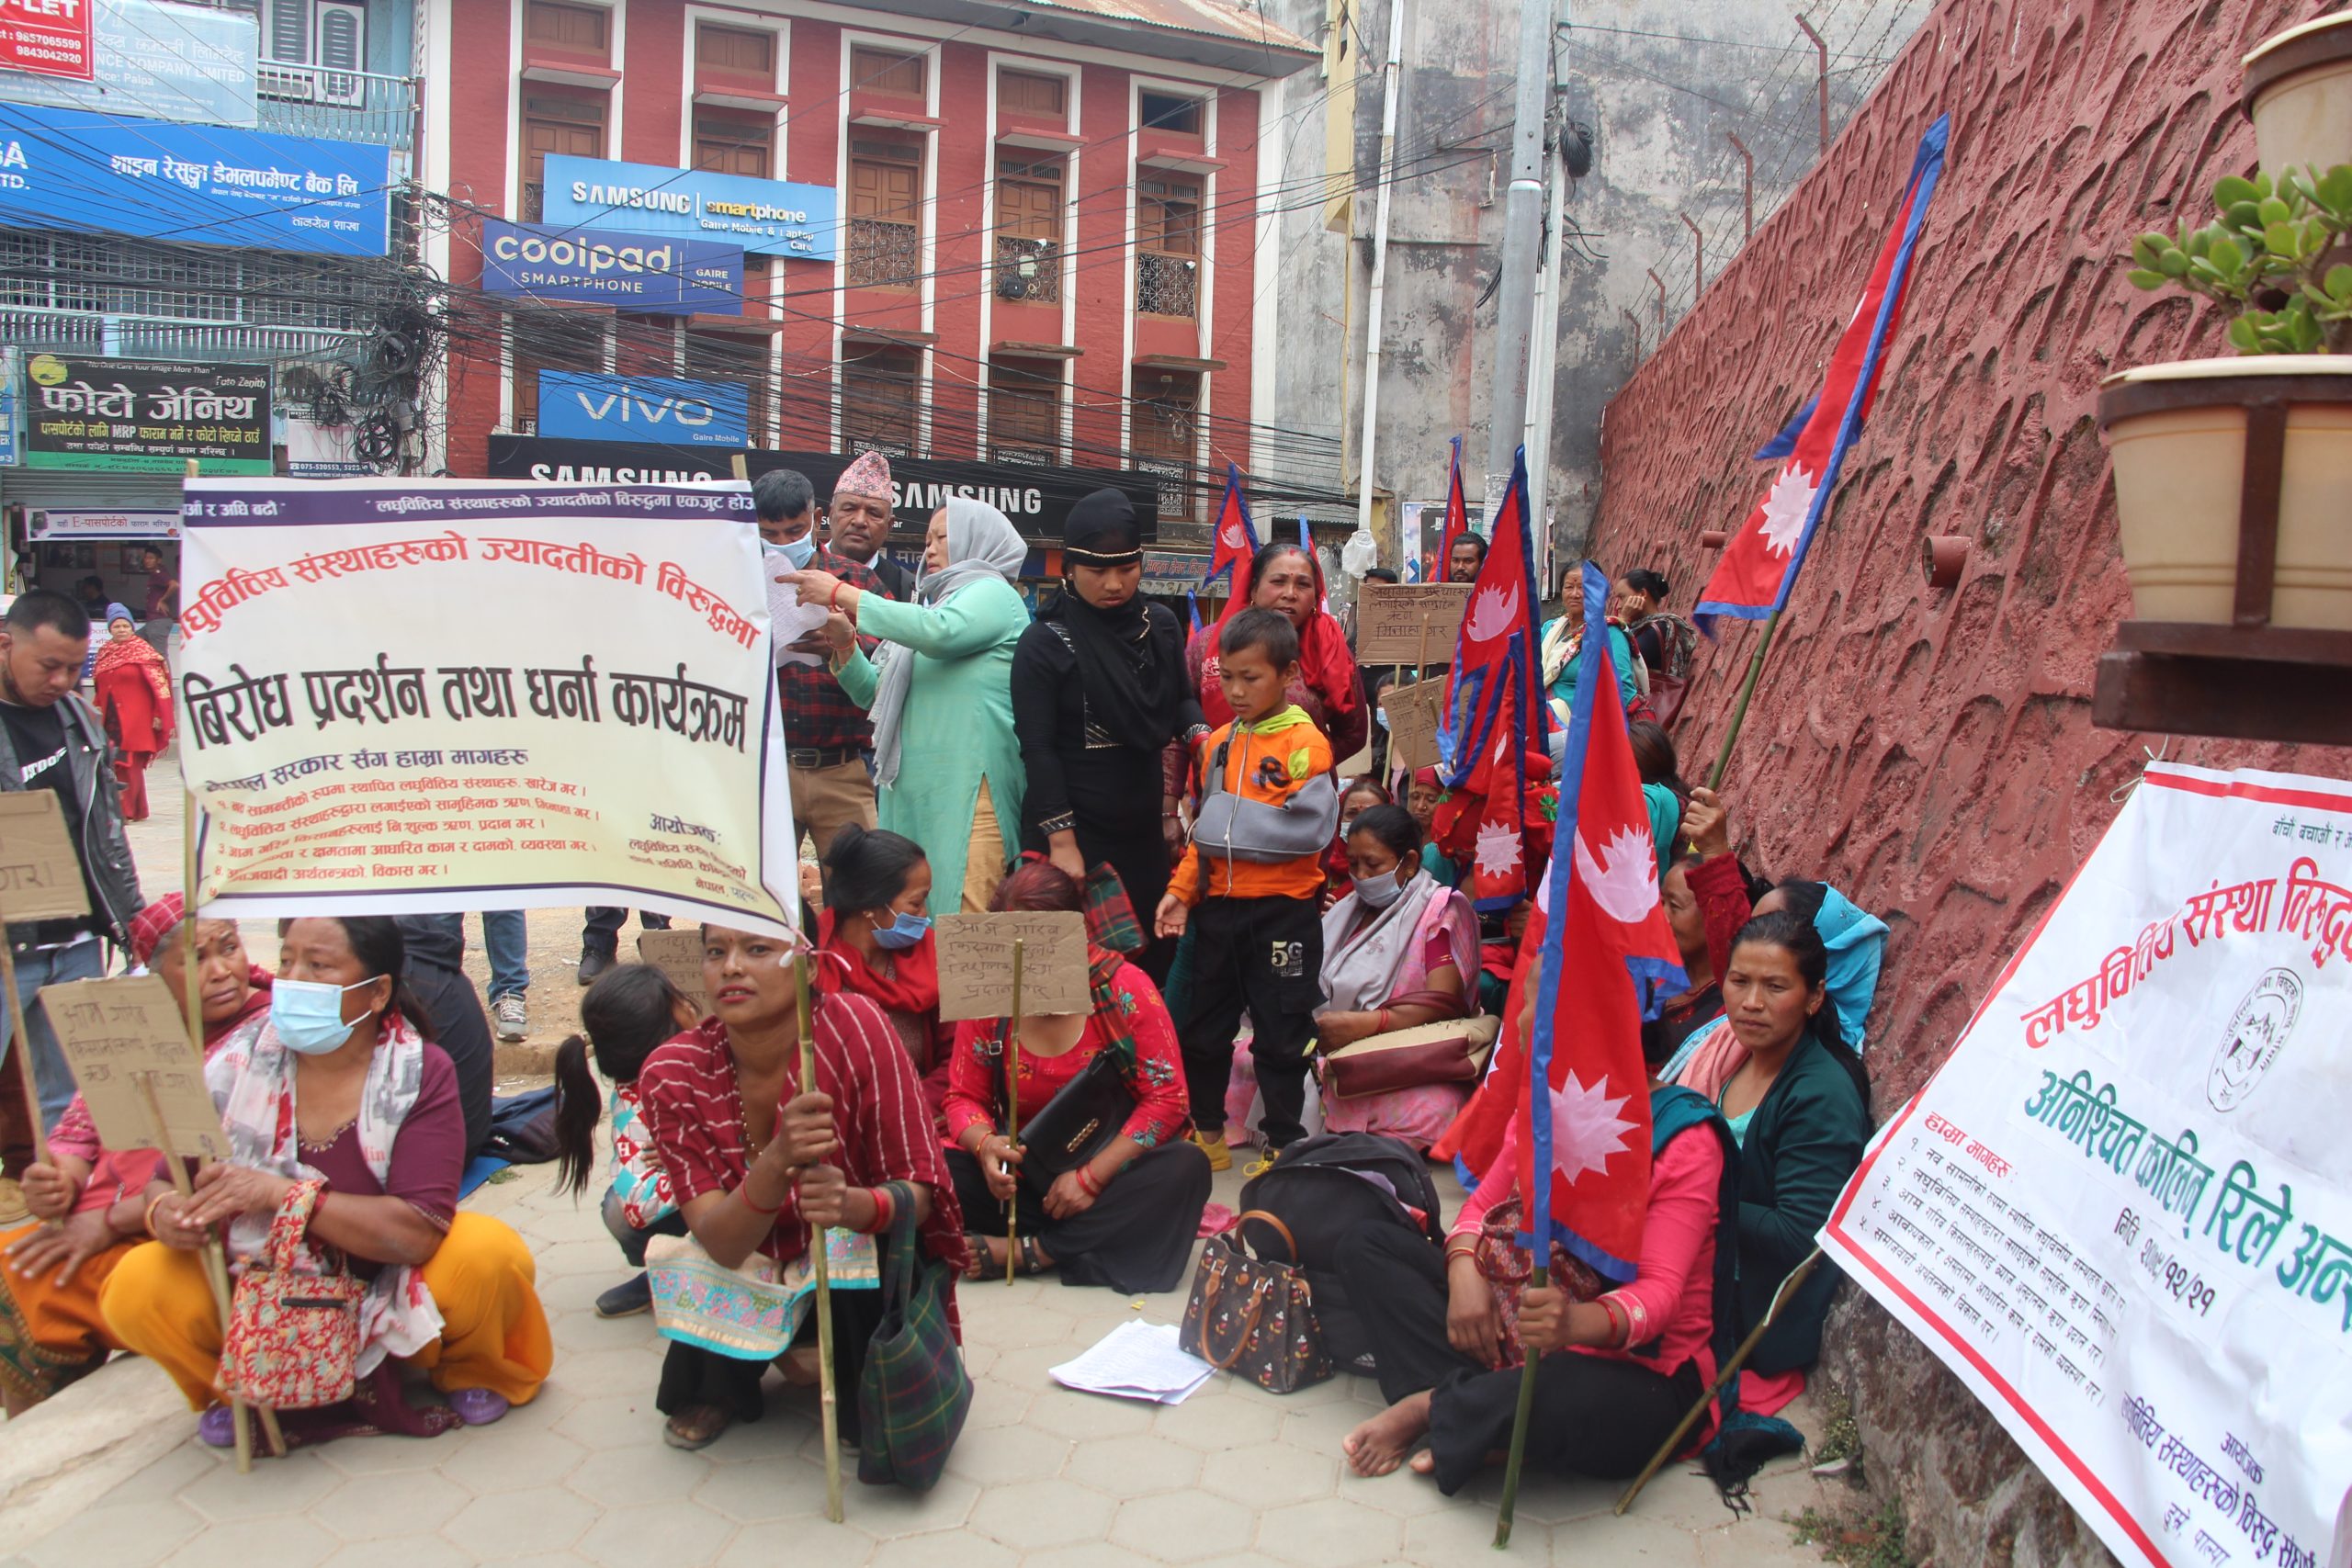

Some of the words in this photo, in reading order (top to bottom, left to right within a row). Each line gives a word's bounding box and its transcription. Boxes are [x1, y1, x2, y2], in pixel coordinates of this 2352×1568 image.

[16, 31, 81, 50] 9857065599
[17, 45, 82, 63] 9843042920
[124, 73, 154, 86] Palpa
[127, 57, 192, 76] COMPANY
[196, 69, 245, 83] LIMITED
[572, 180, 692, 215] SAMSUNG
[706, 200, 807, 223] smartphone
[767, 226, 775, 237] &
[494, 234, 672, 276] coolpad
[521, 272, 643, 294] SMARTPHONE
[695, 269, 729, 280] GAIRE
[238, 376, 266, 389] Zenith
[40, 381, 137, 419] फोटो
[148, 386, 256, 421] जेनिथ
[577, 385, 714, 426] vivo
[87, 422, 109, 438] लागि
[112, 424, 137, 439] MRP
[196, 425, 217, 442] फोटो
[676, 491, 723, 512] एकजुट
[477, 536, 648, 586] ज्यादतीको
[184, 663, 294, 750] बिरोध
[301, 652, 431, 731] प्रदर्शन
[437, 666, 517, 724] तथा
[524, 654, 602, 724] धर्ना
[609, 661, 749, 754] कार्यक्रम
[272, 753, 344, 785] सरकार
[395, 749, 444, 769] हाम्रा
[371, 840, 423, 855] आधारित
[427, 842, 455, 852] काम
[372, 863, 414, 877] विकास
[2182, 878, 2278, 948] संस्था
[2024, 1068, 2149, 1176] अनिश्चित
[2202, 1159, 2294, 1269] रिले
[1898, 1188, 1924, 1212] आम
